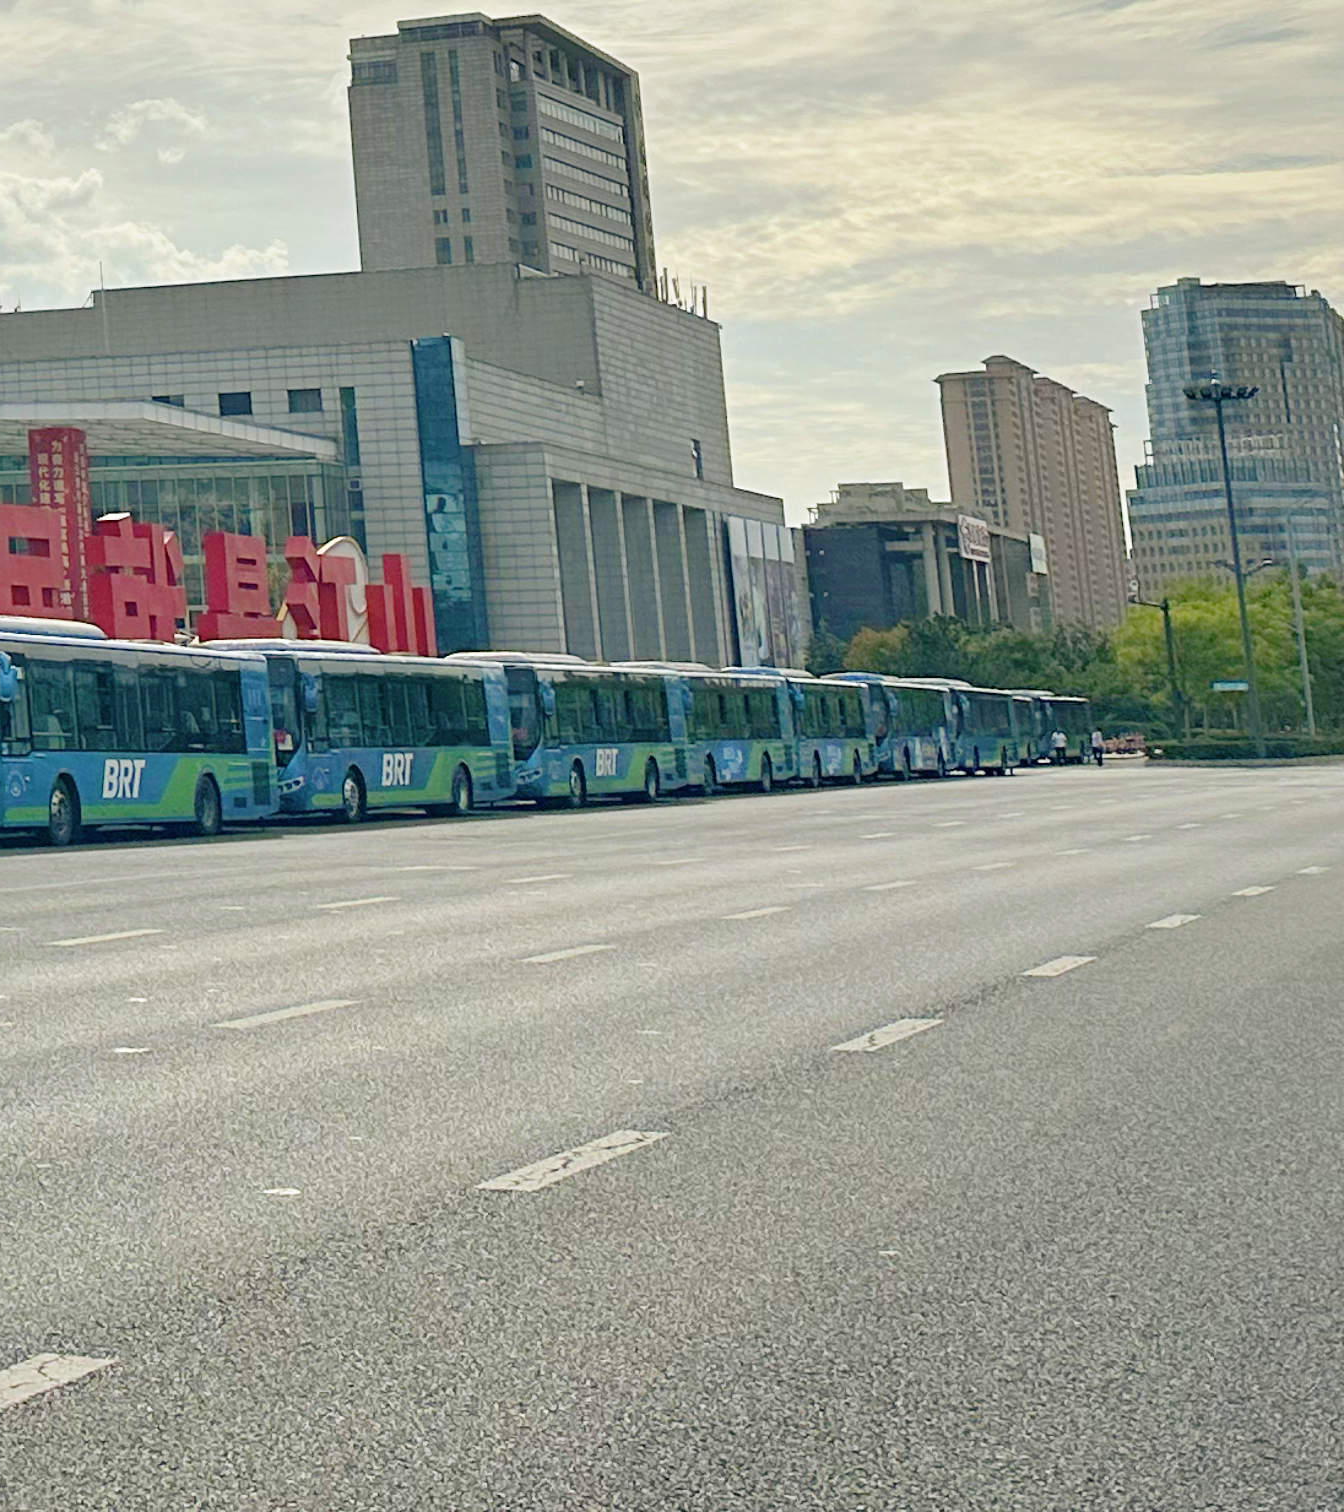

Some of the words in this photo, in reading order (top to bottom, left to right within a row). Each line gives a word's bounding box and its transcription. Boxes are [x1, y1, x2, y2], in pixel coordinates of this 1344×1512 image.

[103, 759, 145, 798] BRT
[382, 753, 413, 786] BRT
[596, 748, 618, 776] BRT
